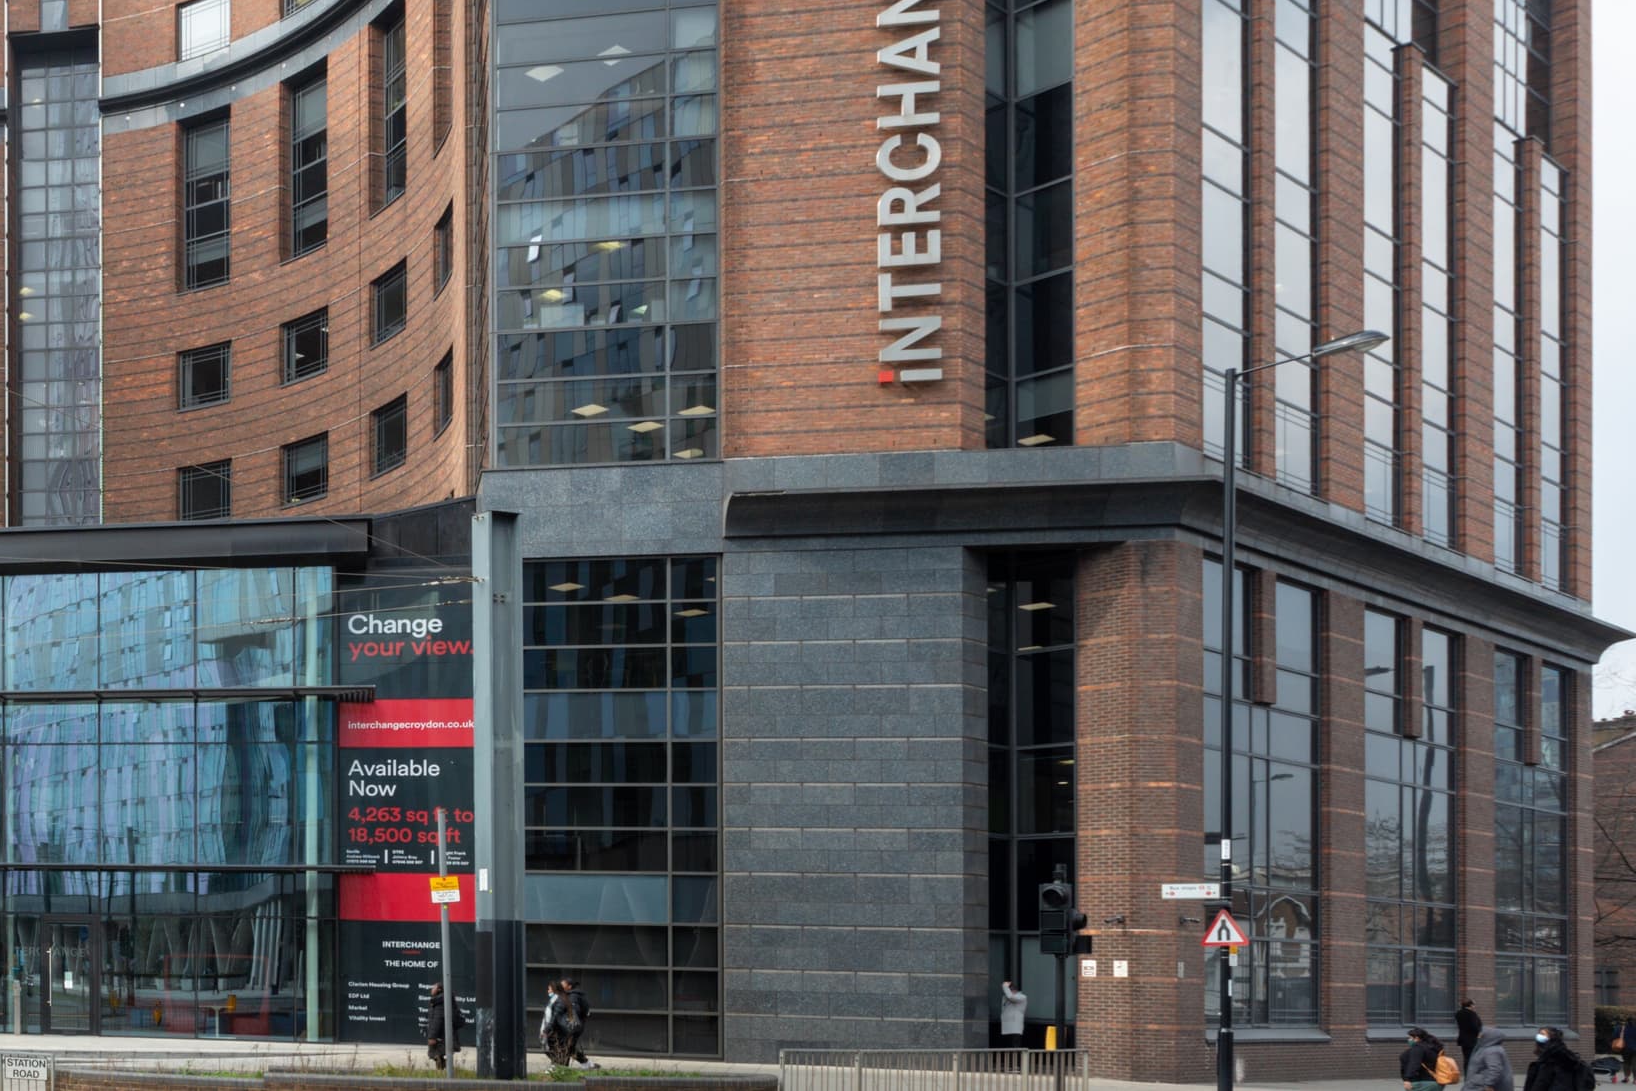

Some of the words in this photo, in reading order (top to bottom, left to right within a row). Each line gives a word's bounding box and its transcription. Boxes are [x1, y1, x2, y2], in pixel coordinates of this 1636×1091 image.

[348, 614, 443, 638] Change
[348, 641, 405, 662] your
[411, 635, 474, 655] view.
[348, 720, 474, 731] interchangecroydon.co.uk
[348, 759, 440, 776] Available
[349, 780, 396, 796] Now
[348, 807, 401, 824] 4,263
[406, 810, 428, 825] sq
[454, 808, 474, 823] to
[348, 827, 412, 844] 18,500
[417, 832, 439, 846] sq
[445, 826, 460, 843] ft
[382, 941, 441, 949] INTERCHANGE
[384, 959, 400, 967] THE
[402, 960, 426, 968] HOME
[7, 1058, 46, 1068] STATION
[13, 1069, 40, 1079] ROAD
